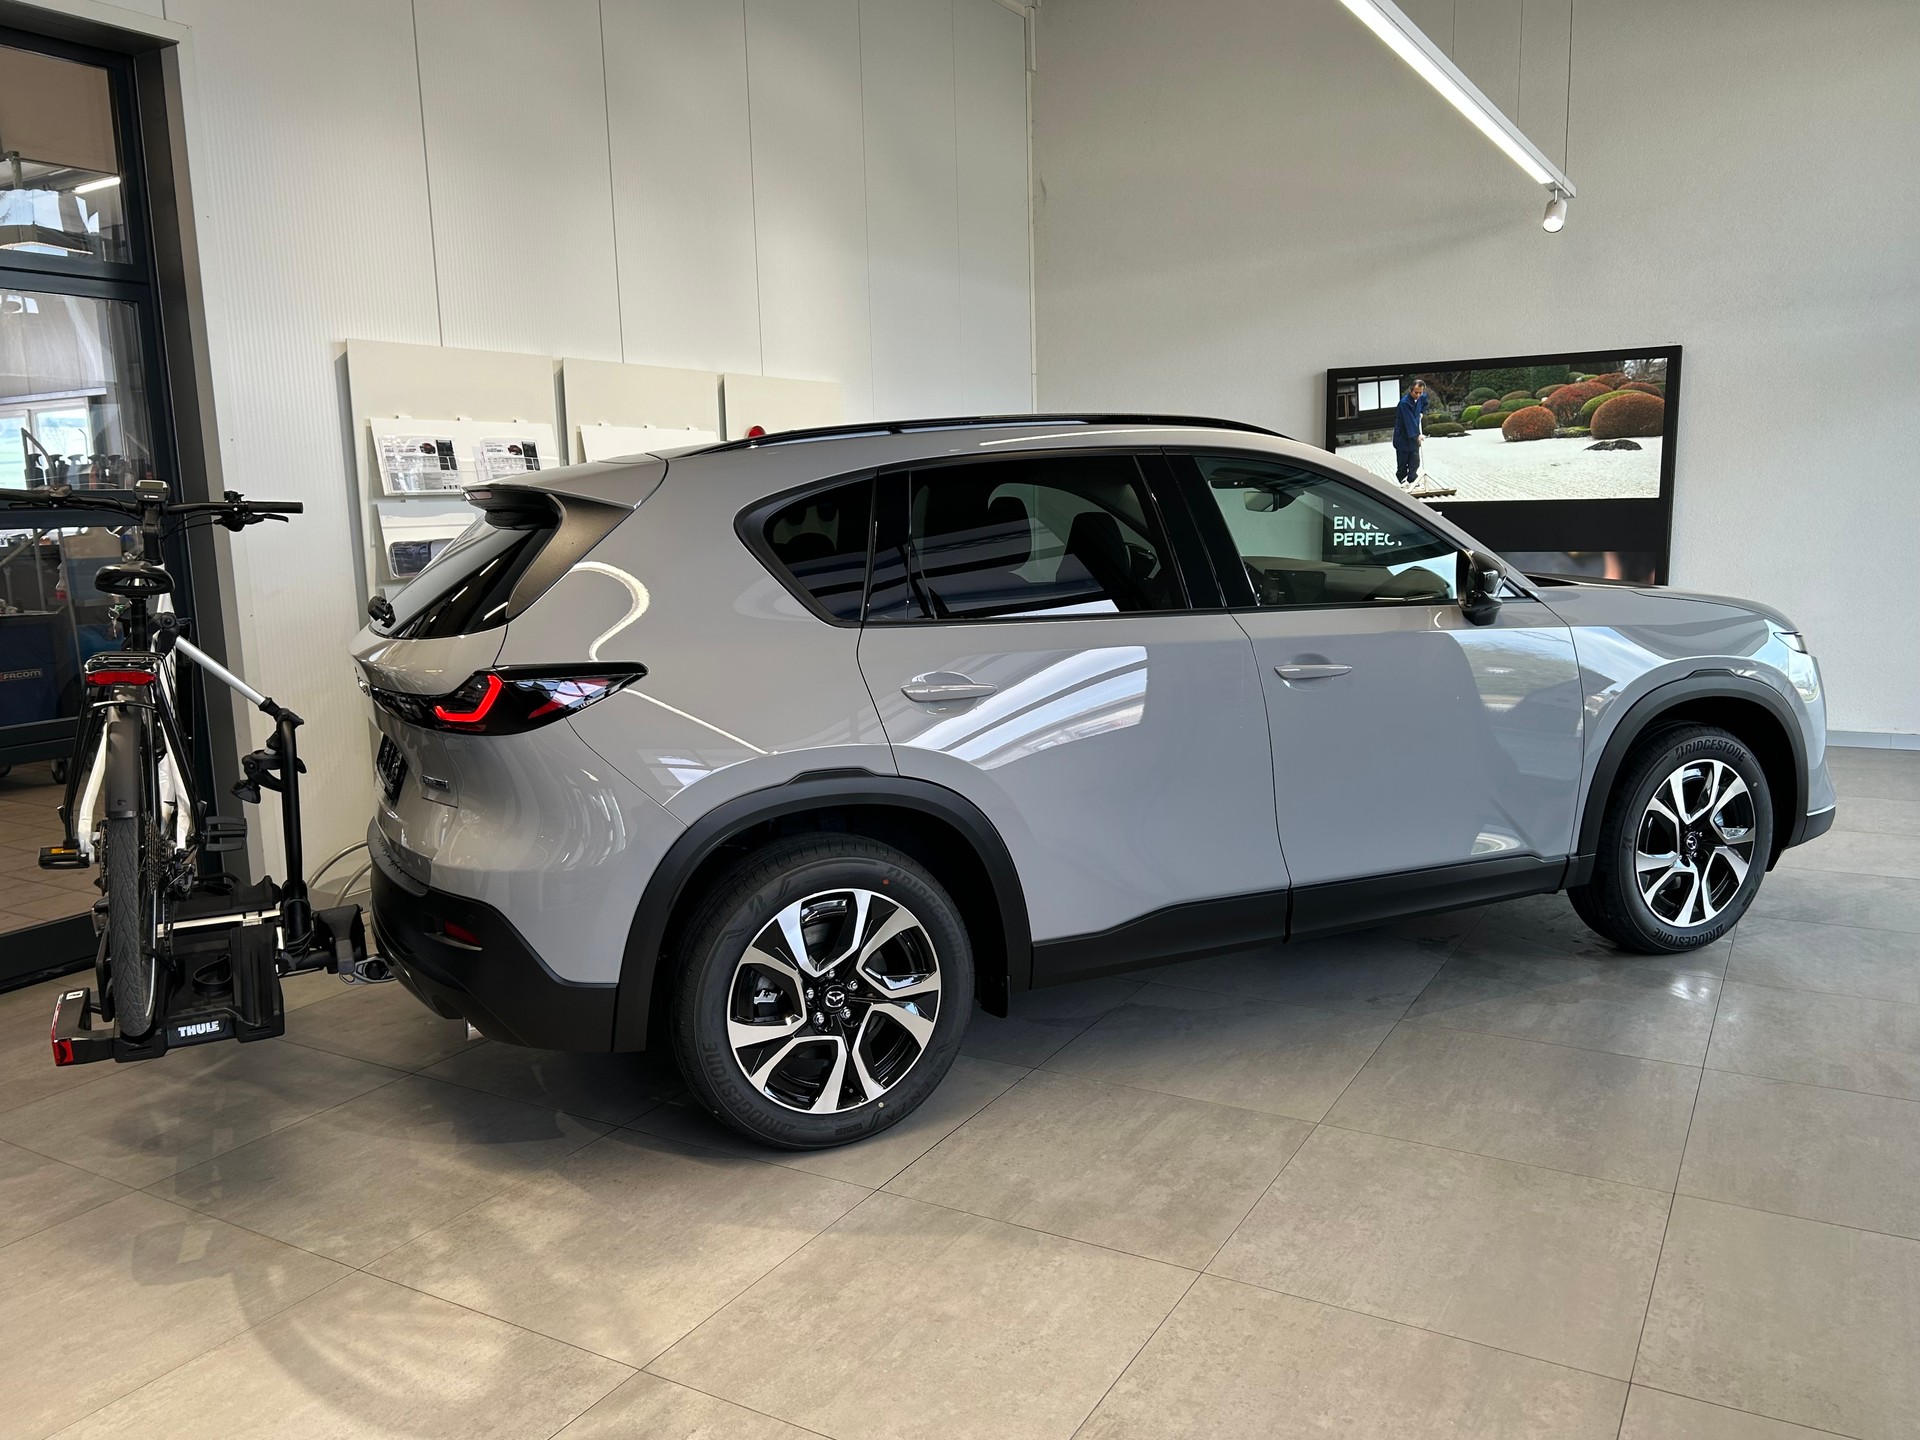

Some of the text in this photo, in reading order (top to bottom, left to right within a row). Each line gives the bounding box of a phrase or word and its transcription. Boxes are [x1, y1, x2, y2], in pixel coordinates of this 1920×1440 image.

[1333, 516, 1355, 530] EN
[3, 670, 41, 680] FACOM
[1674, 739, 1747, 762] BRIDGESTONE
[886, 866, 965, 967] BRIDGESTONE
[1654, 925, 1725, 947] BRIDGESTONE
[177, 1020, 220, 1037] THULE
[701, 1041, 796, 1138] BRIDGESTONE
